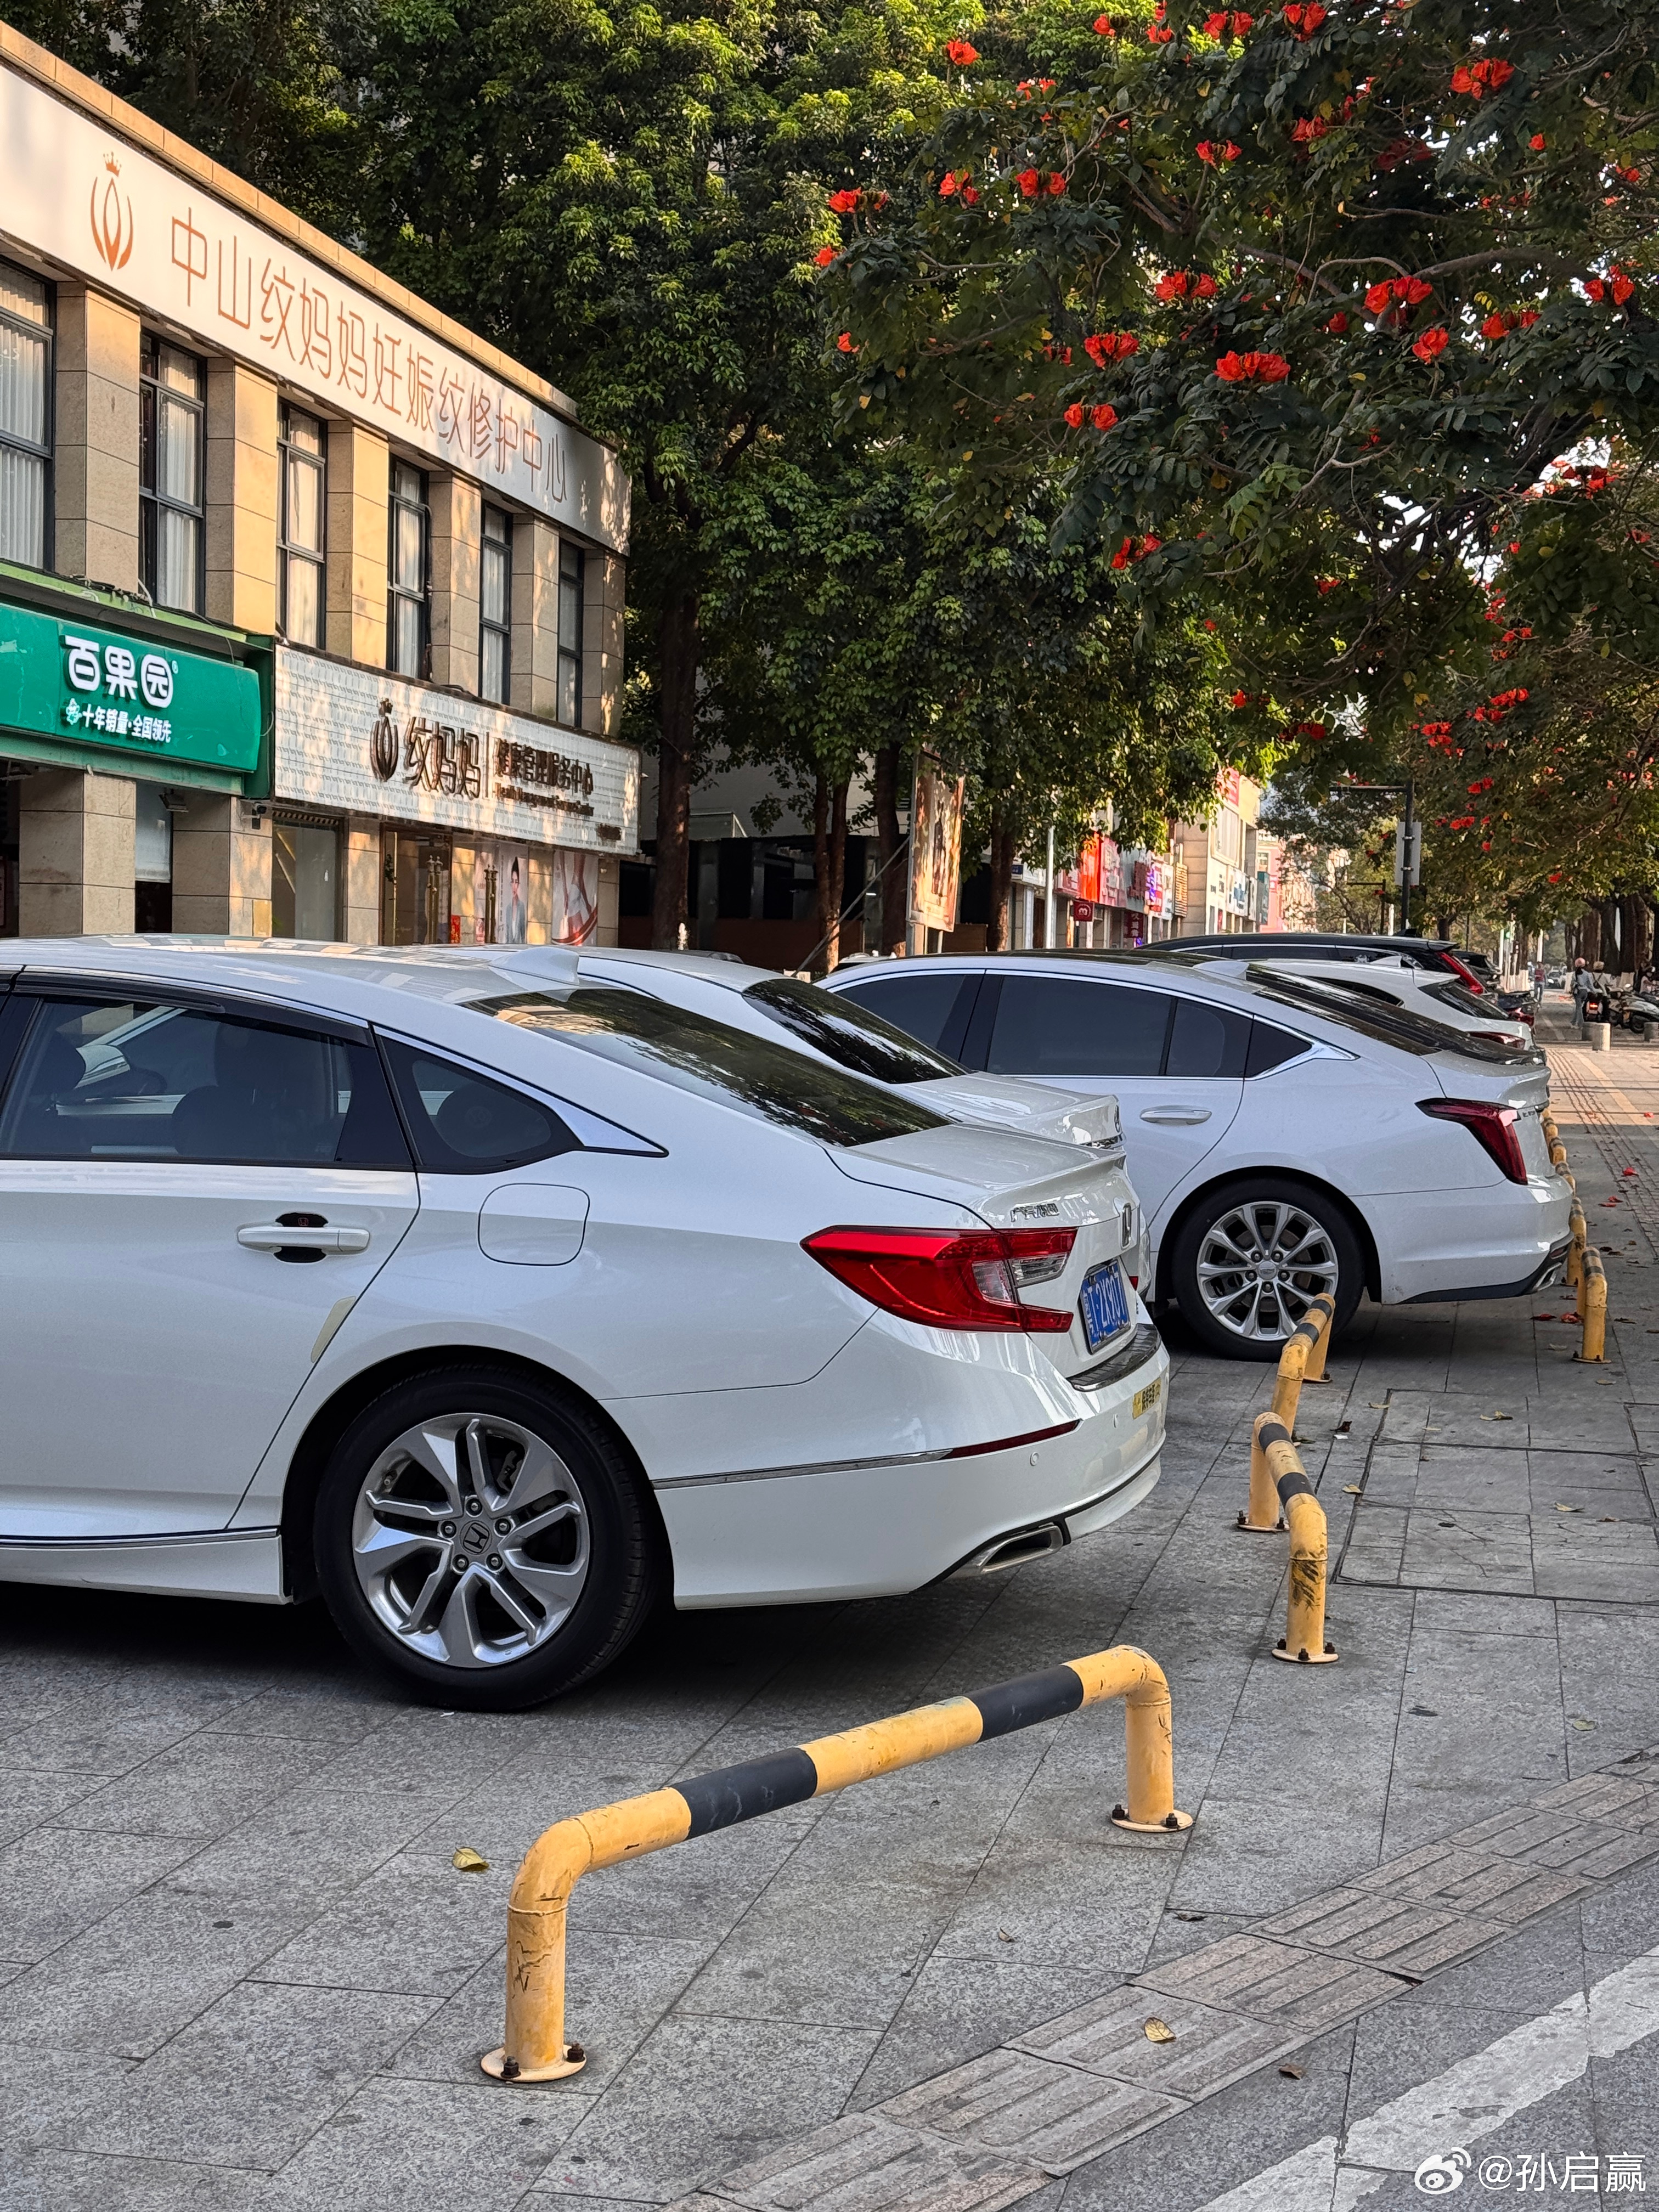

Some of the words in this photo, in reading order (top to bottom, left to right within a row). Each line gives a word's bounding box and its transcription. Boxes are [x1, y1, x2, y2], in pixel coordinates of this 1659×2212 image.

[172, 207, 567, 503] 中山纹妈妈妊娠纹修护中心
[65, 635, 173, 708] 百果园
[403, 716, 482, 801] 纹妈妈
